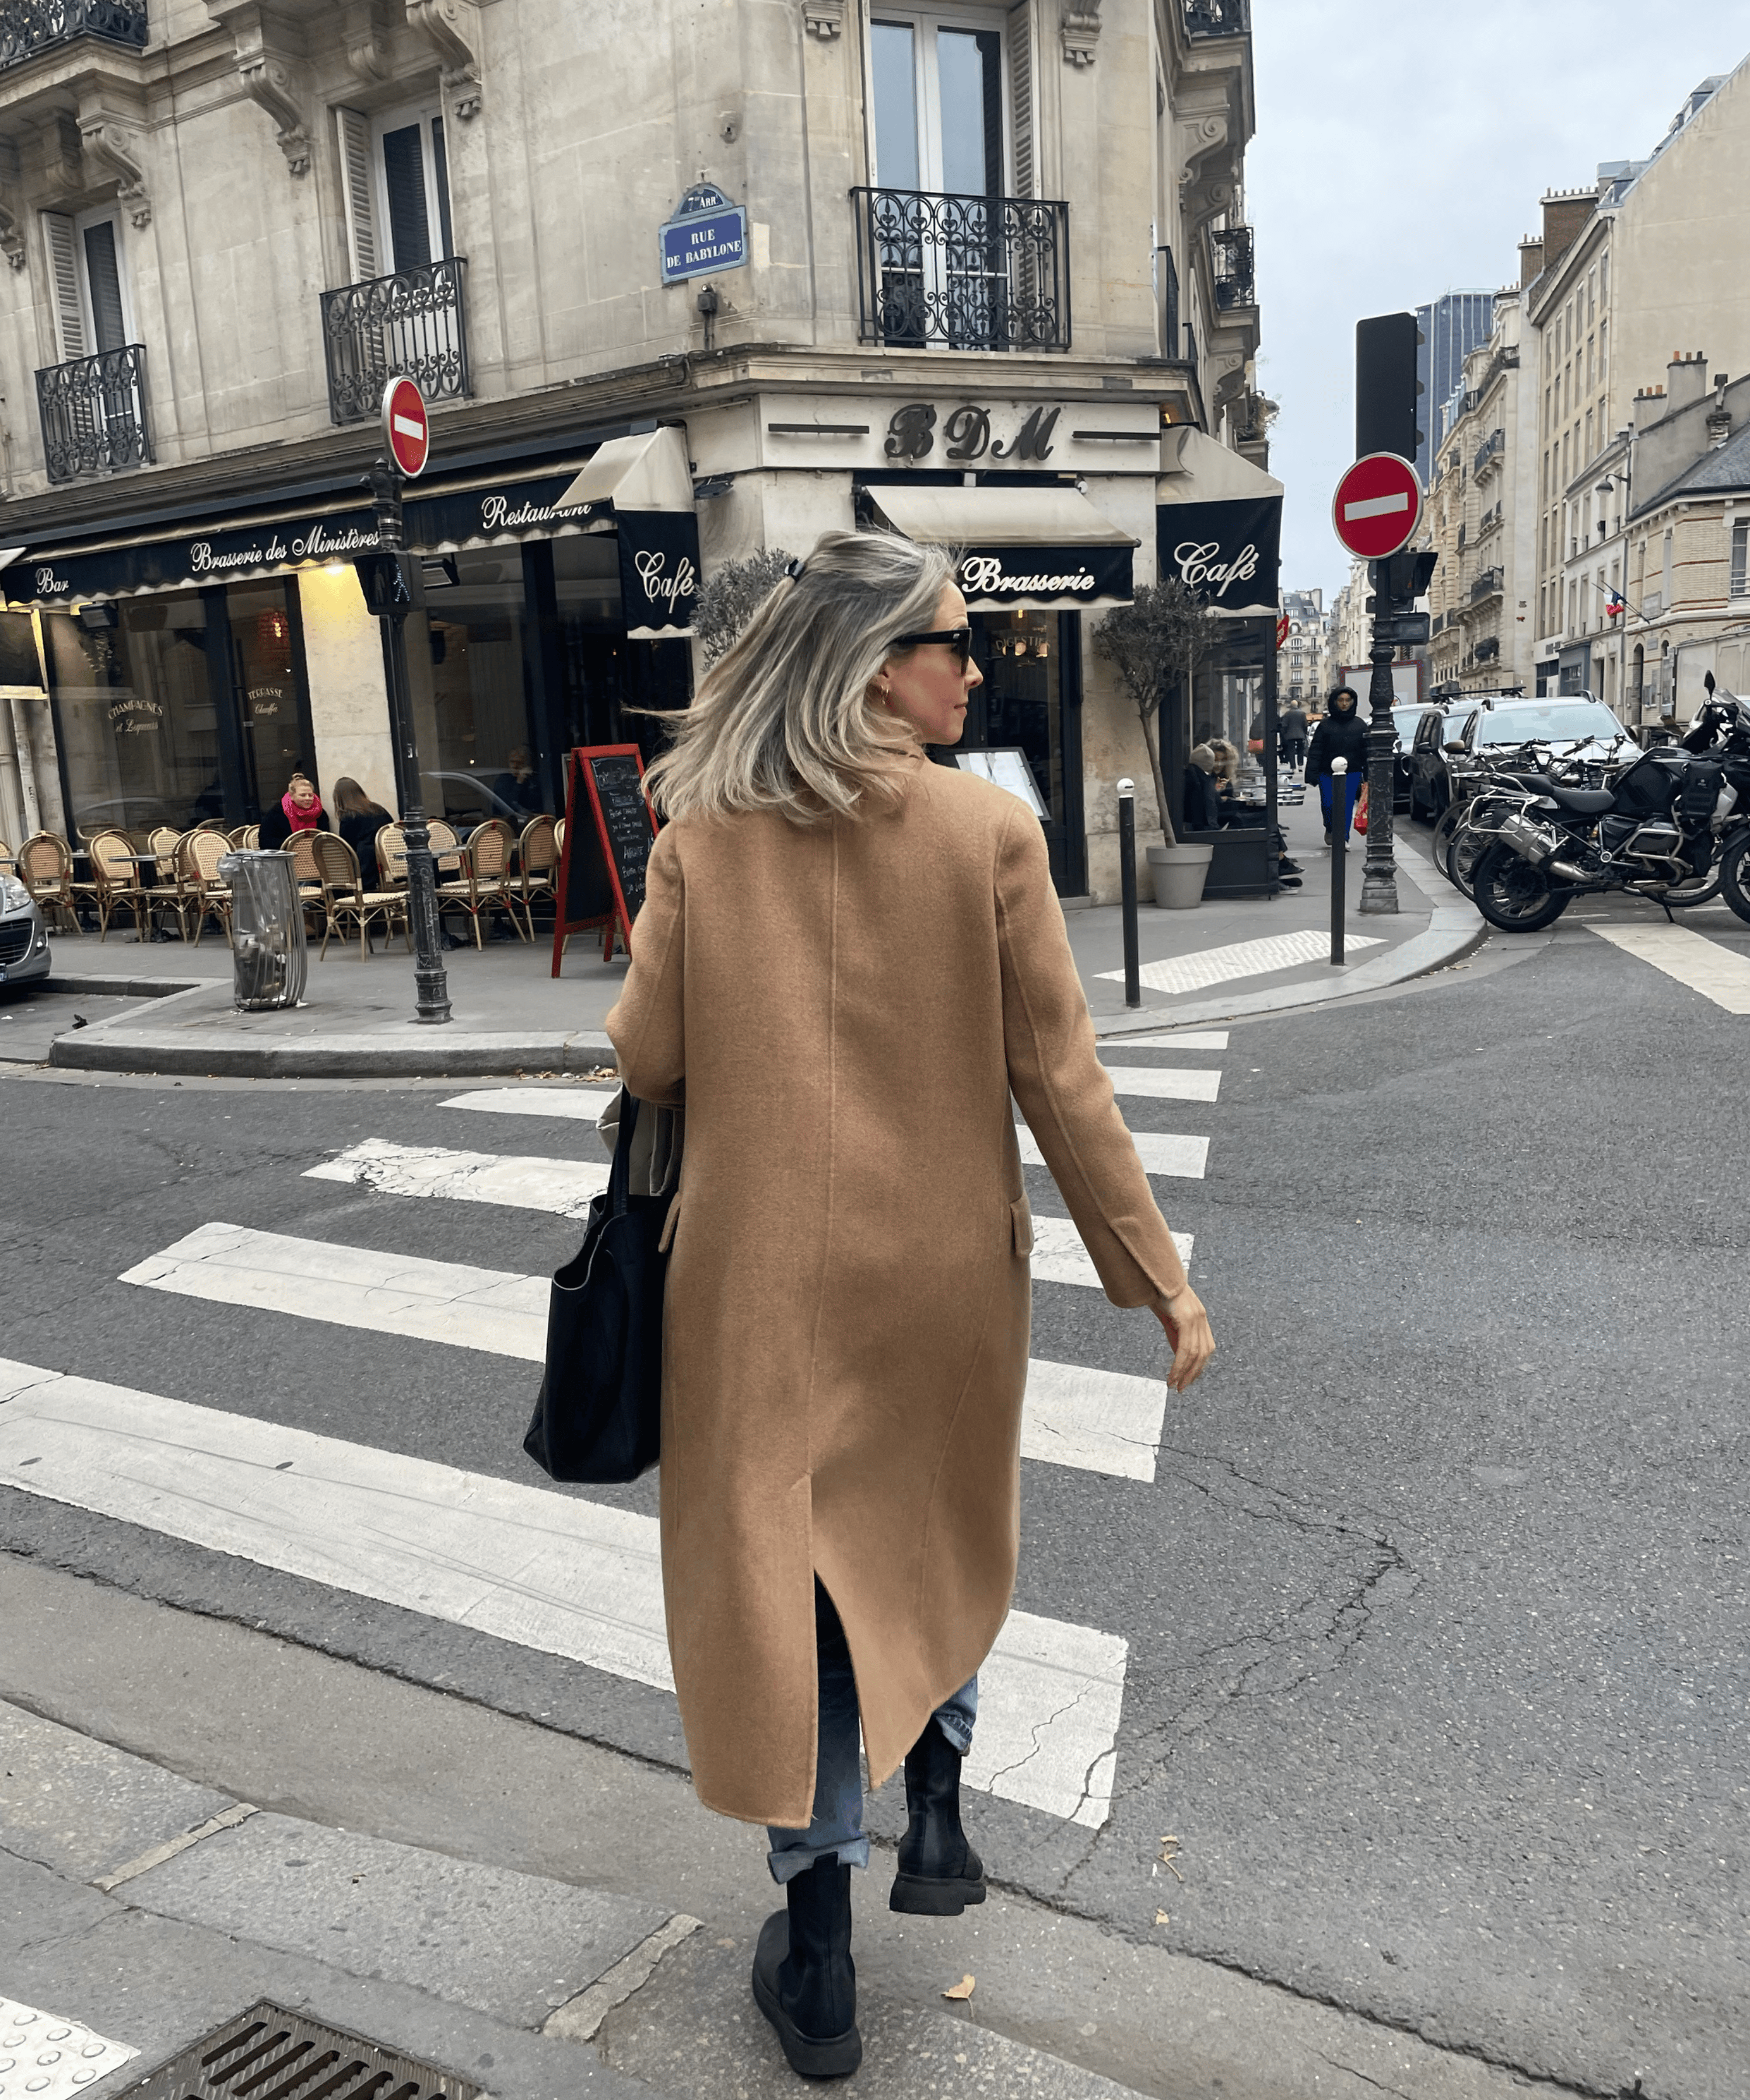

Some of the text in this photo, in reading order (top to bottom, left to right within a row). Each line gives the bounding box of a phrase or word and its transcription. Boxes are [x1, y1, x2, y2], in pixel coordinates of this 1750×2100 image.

[691, 229, 715, 245] RUE
[667, 240, 741, 268] DE BABYLONE
[191, 525, 380, 572] Brasserie des Ministères
[36, 567, 69, 594] Bar
[635, 550, 695, 614] Café
[961, 557, 1095, 592] Brasserie
[1174, 543, 1259, 597] Café
[247, 687, 283, 700] TERRASSE
[108, 700, 163, 719] CHAMPAGNES
